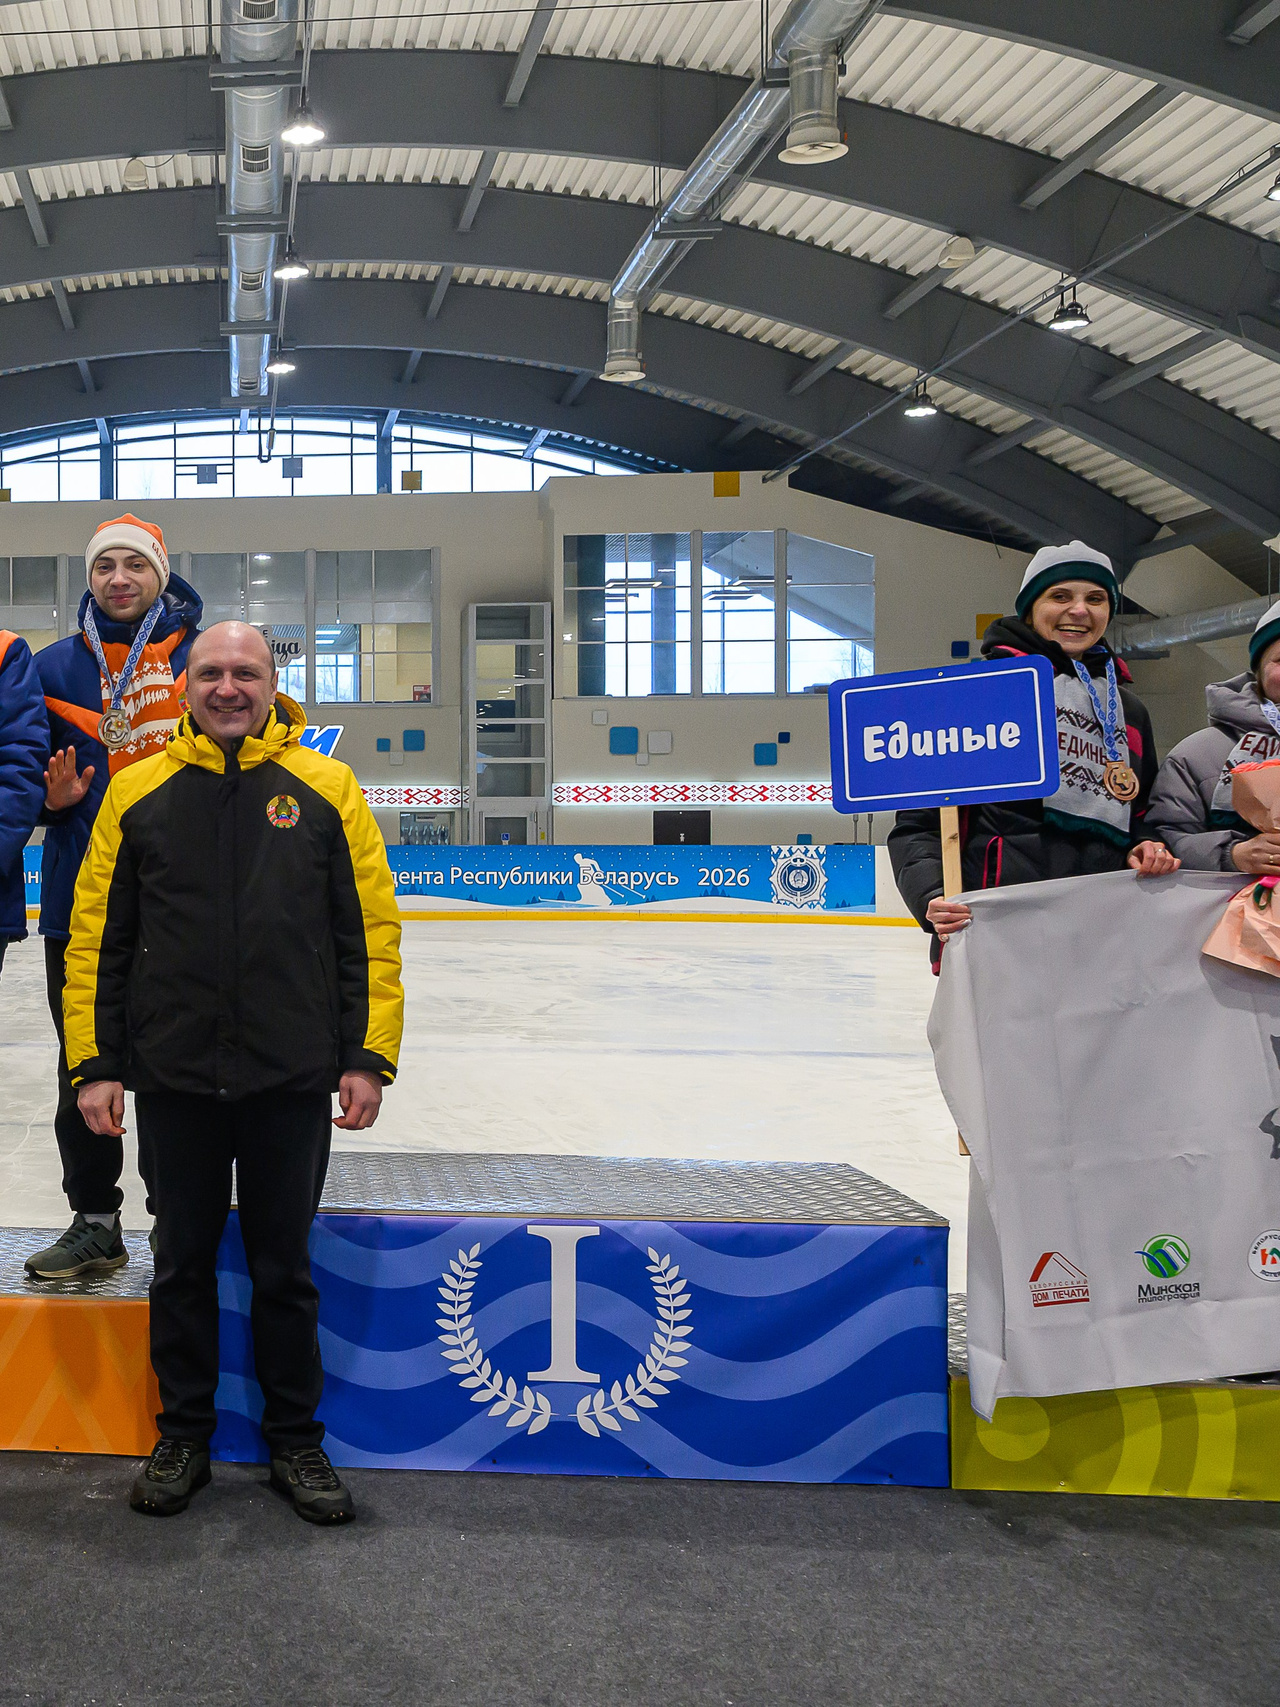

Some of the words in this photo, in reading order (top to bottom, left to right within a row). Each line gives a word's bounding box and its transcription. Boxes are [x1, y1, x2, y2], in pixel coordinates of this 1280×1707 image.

[863, 720, 1020, 763] Единые
[450, 866, 573, 890] Республики
[579, 867, 680, 890] Беларусь
[697, 867, 751, 887] 2026
[1029, 1279, 1089, 1290] БЕЛОРУССКИЙ
[1138, 1282, 1200, 1298] Минская
[1032, 1292, 1050, 1303] ДОМ
[1053, 1288, 1090, 1300] ПЕЧАТИ
[1138, 1292, 1200, 1304] типография
